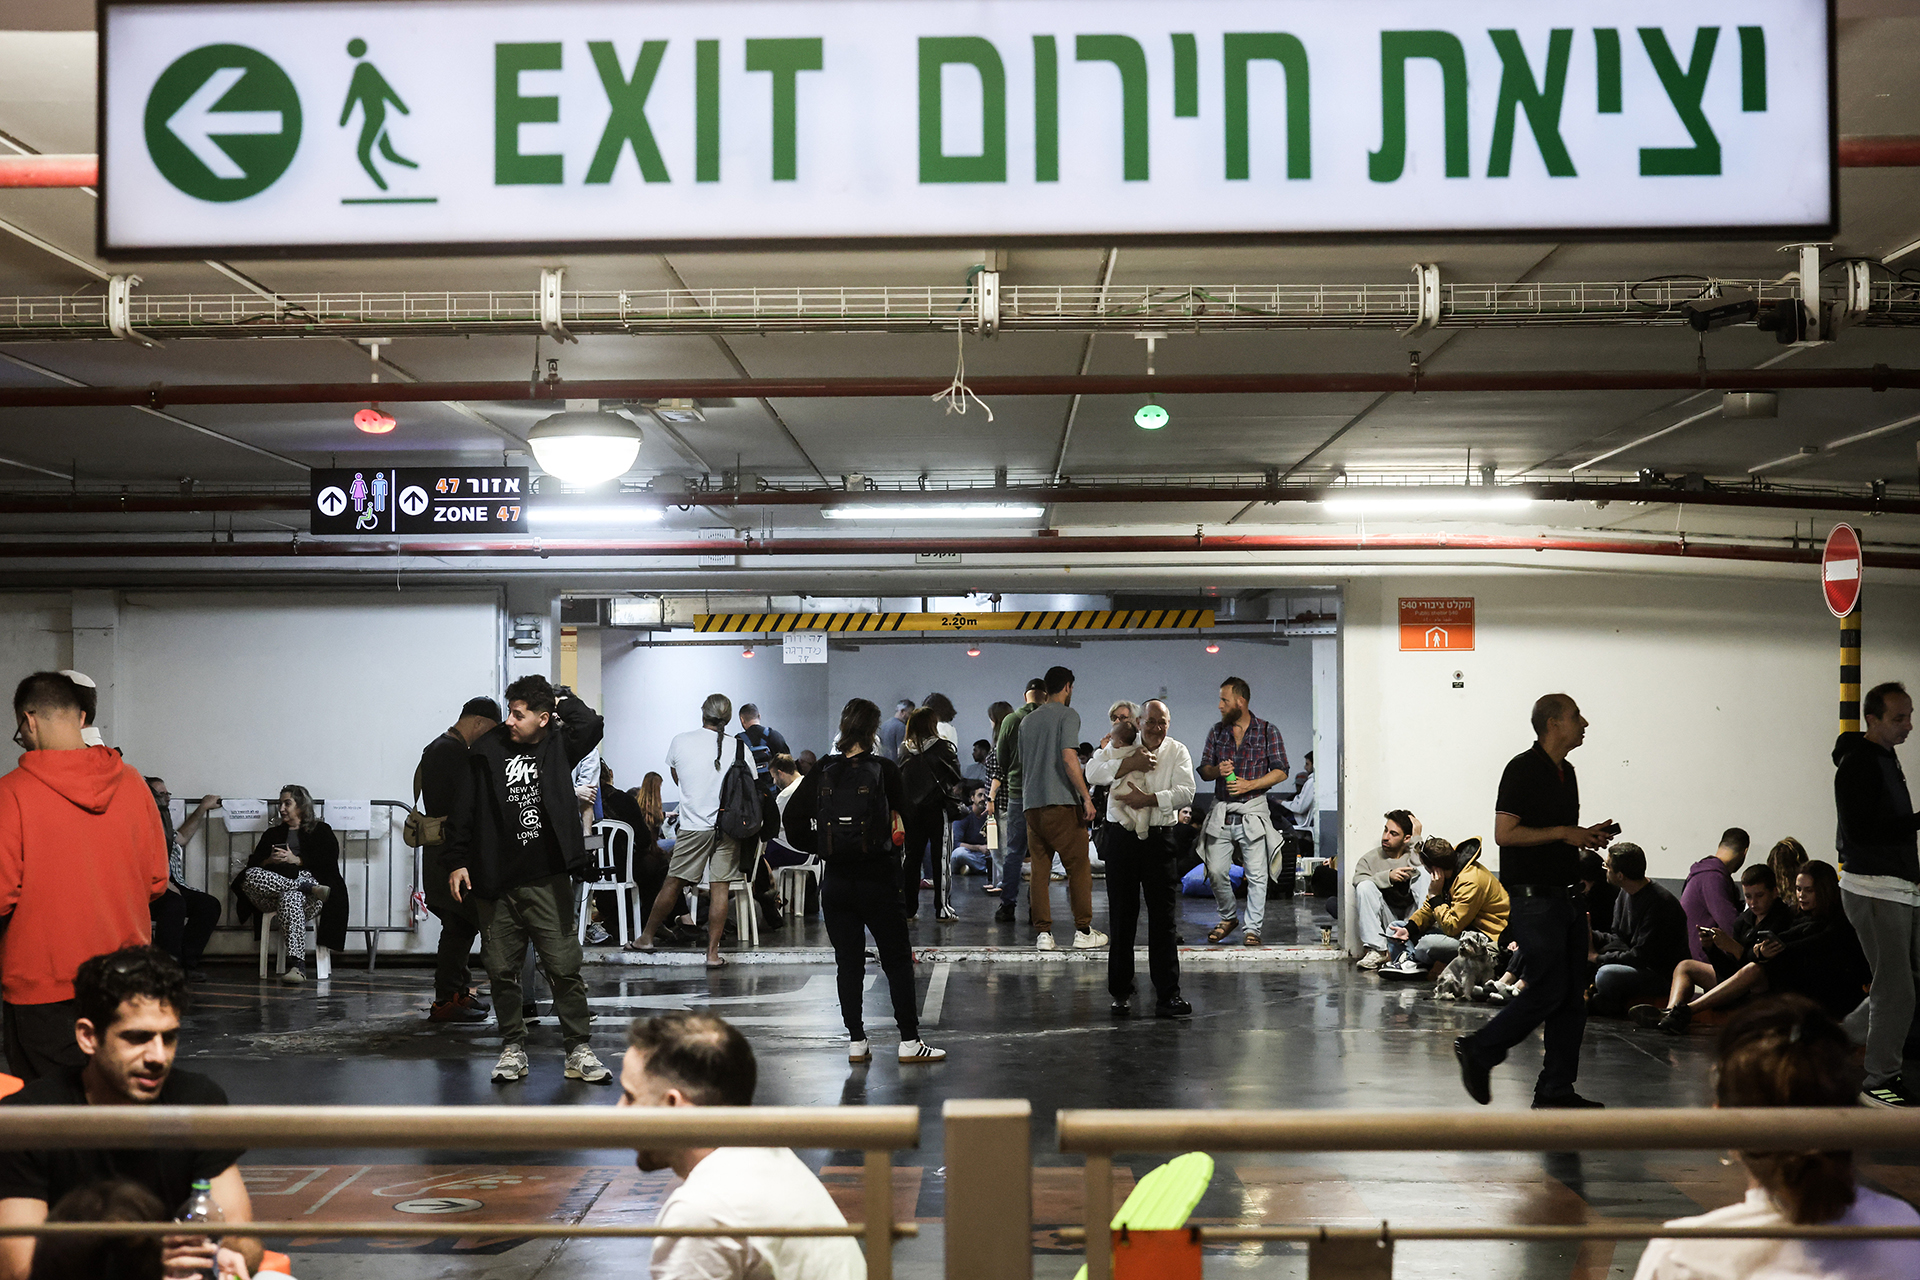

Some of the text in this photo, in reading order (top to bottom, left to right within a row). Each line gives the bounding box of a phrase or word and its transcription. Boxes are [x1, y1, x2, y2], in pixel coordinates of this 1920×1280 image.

[495, 39, 822, 185] EXIT
[919, 26, 1768, 184] יציאת חירום
[435, 477, 520, 494] אזור 47
[433, 505, 521, 522] ZONE 47
[1401, 600, 1472, 611] מקלט ציבורי 540
[941, 616, 977, 626] 2.20m
[509, 786, 528, 794] NEW
[506, 794, 520, 803] OS
